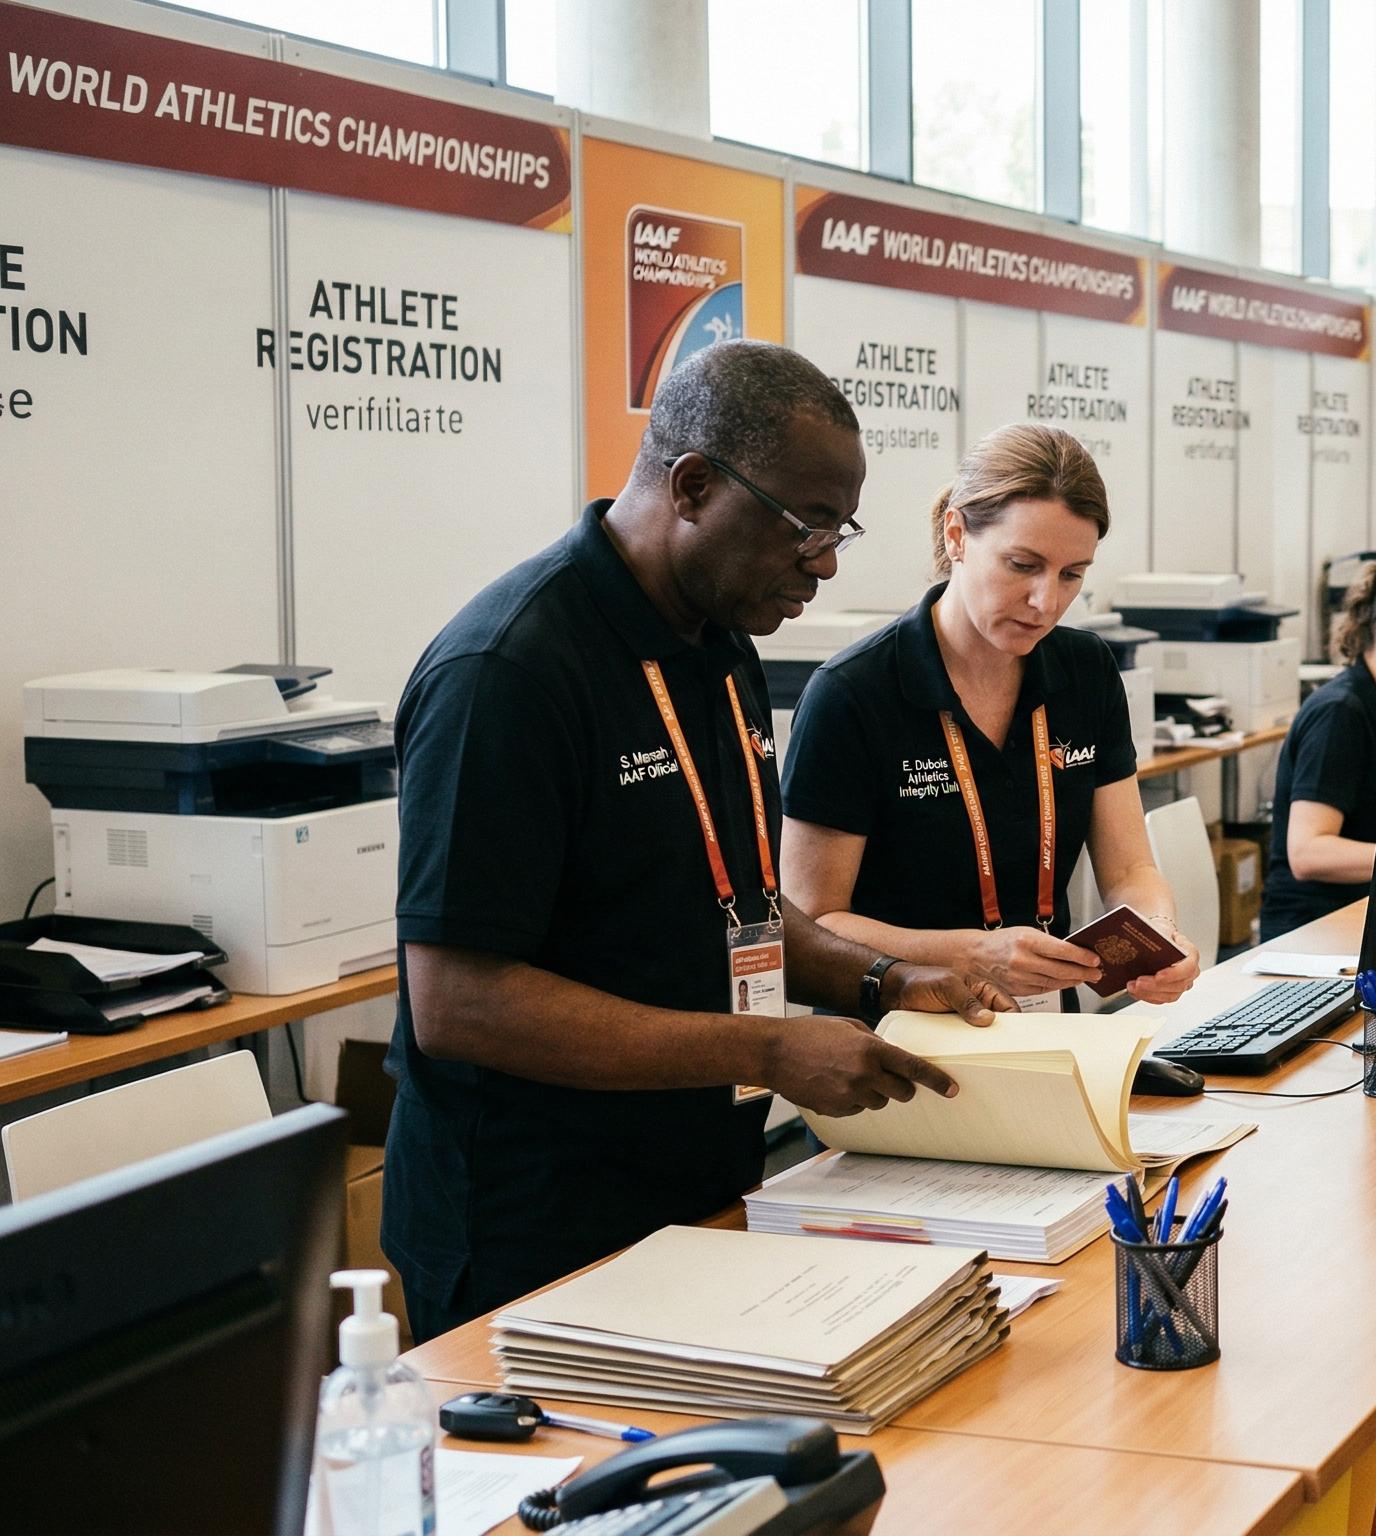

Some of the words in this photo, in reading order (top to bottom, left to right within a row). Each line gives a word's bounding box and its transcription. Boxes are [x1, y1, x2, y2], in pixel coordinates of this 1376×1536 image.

[8, 52, 148, 114] WORLD
[155, 82, 331, 147] ATHLETICS
[337, 117, 550, 189] CHAMPIONSHIPS
[634, 221, 682, 249] IAAF
[634, 247, 673, 268] WORLD
[821, 217, 880, 256] IAAF
[883, 229, 944, 267] WORLD
[945, 241, 1027, 281] ATHLETICS
[1029, 257, 1134, 299] CHAMPIONSHIPS
[309, 279, 458, 331] ATHLETE
[1171, 285, 1207, 313] IAAF
[256, 328, 502, 383] REGISTRATION
[856, 342, 937, 376] ATHLETE
[1048, 362, 1109, 391] ATHLETE
[1027, 394, 1127, 422] REGISTRATION
[620, 755, 633, 768] S.
[915, 758, 948, 771] Dubois
[1066, 745, 1096, 764] IAAF
[619, 767, 646, 786] IAAF
